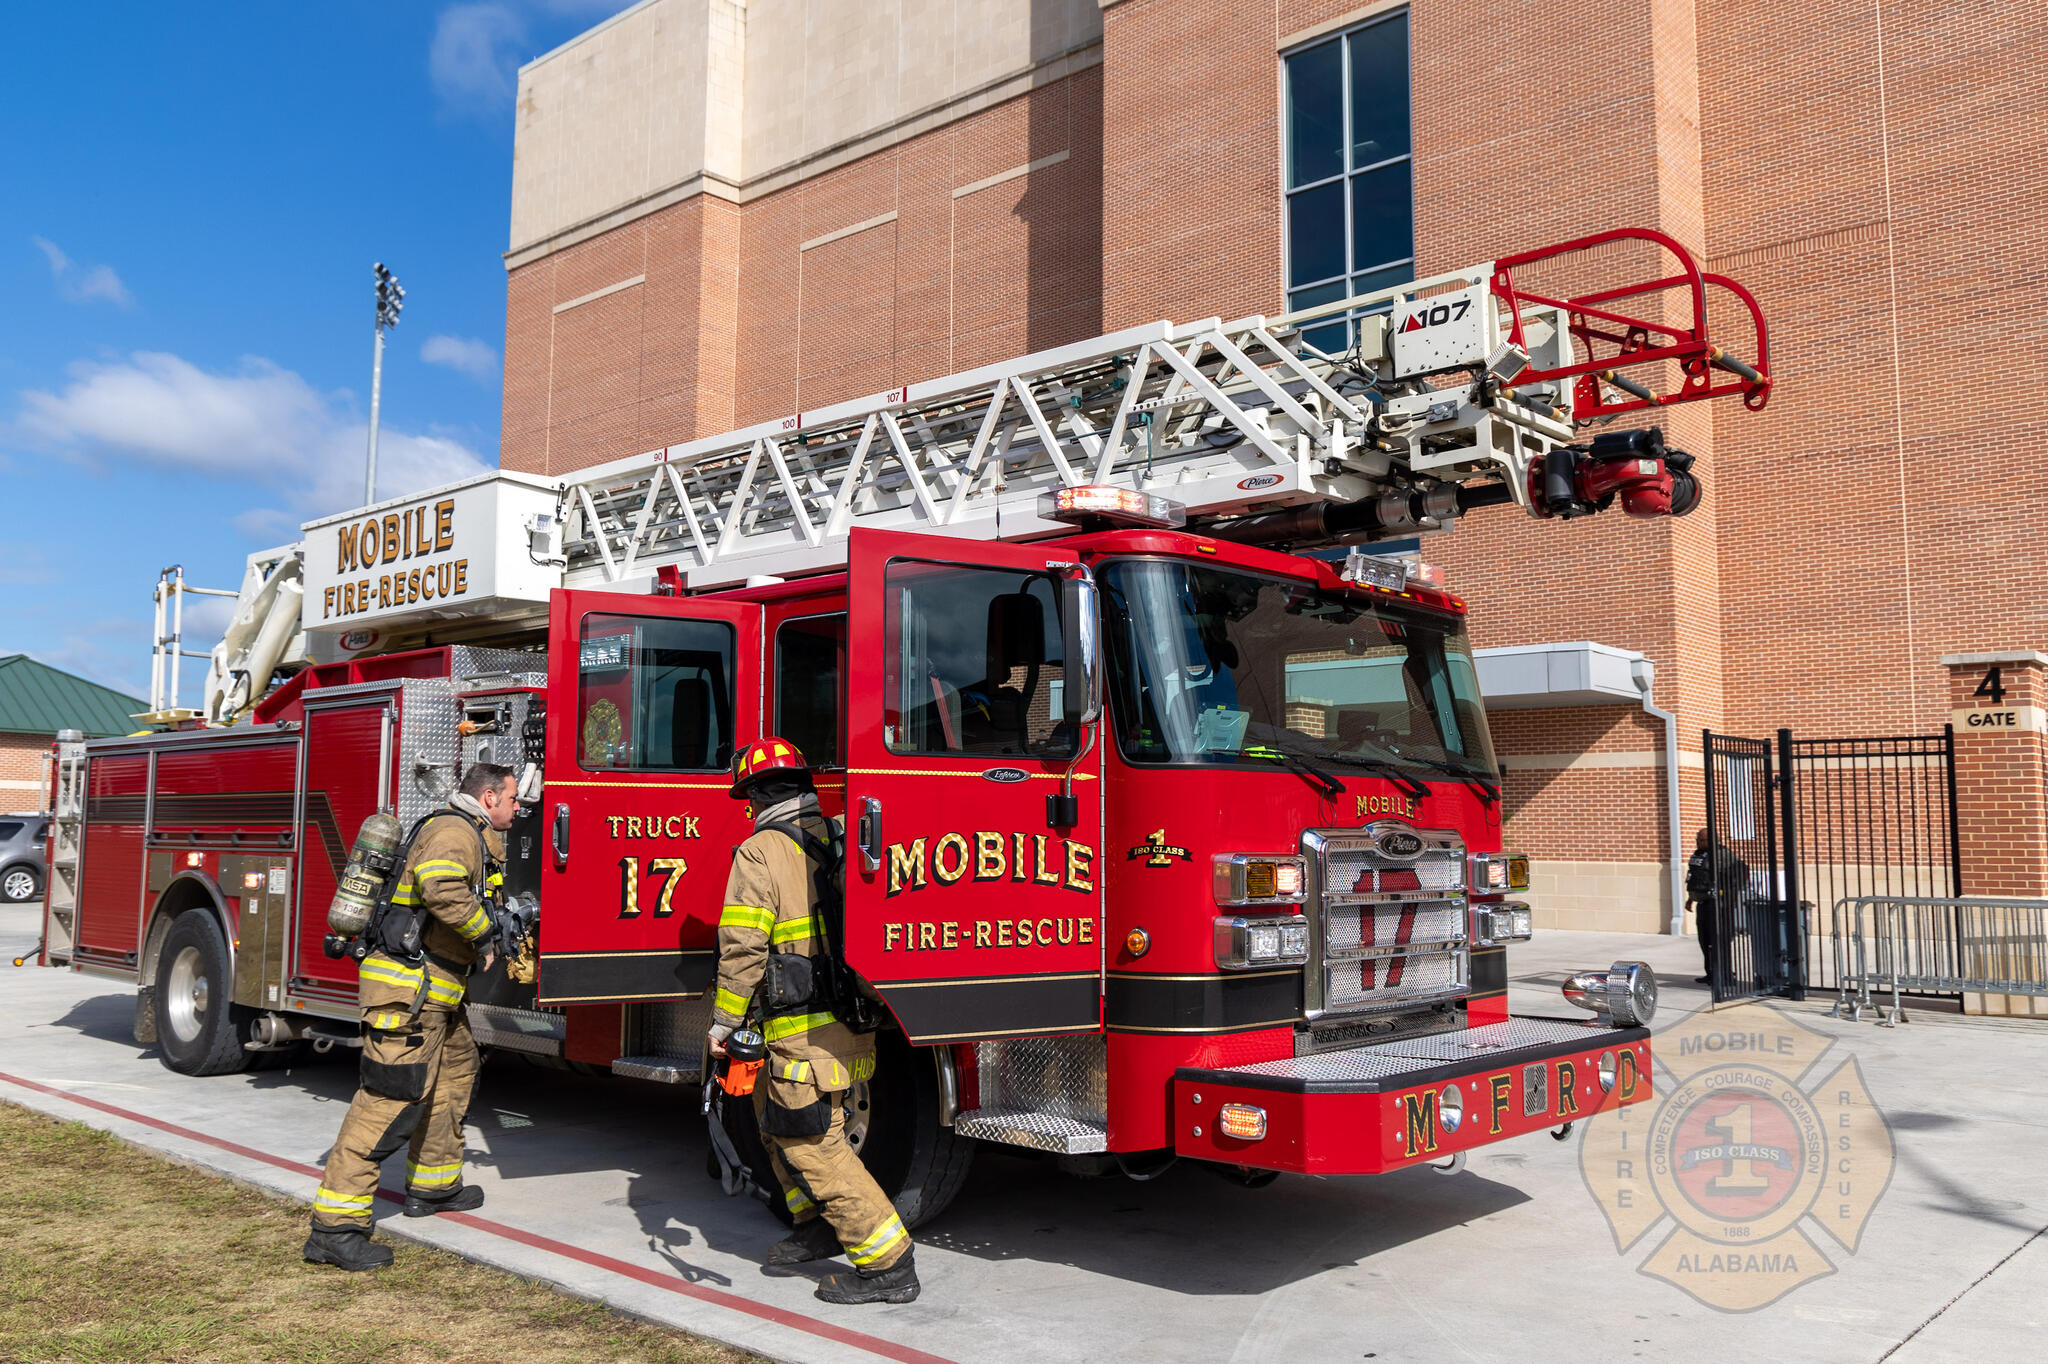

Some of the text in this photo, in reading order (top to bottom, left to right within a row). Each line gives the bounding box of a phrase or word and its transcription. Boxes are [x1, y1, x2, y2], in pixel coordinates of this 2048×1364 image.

[1417, 299, 1472, 329] 107
[886, 391, 900, 403] 107
[782, 418, 795, 429] 100
[653, 452, 663, 462] 90
[337, 498, 454, 575] MOBILE
[323, 558, 468, 619] FIRE-RESCUE
[1972, 667, 2006, 704] 4
[1967, 712, 2016, 727] GATE
[1356, 795, 1414, 819] MOBILE
[605, 815, 701, 839] TRUCK
[1152, 846, 1185, 856] CLASS
[884, 831, 1095, 899] MOBILE
[342, 879, 369, 894] MSA
[616, 856, 689, 920] 17
[883, 916, 1095, 952] FIRE-RESCUE
[1352, 868, 1421, 990] 17
